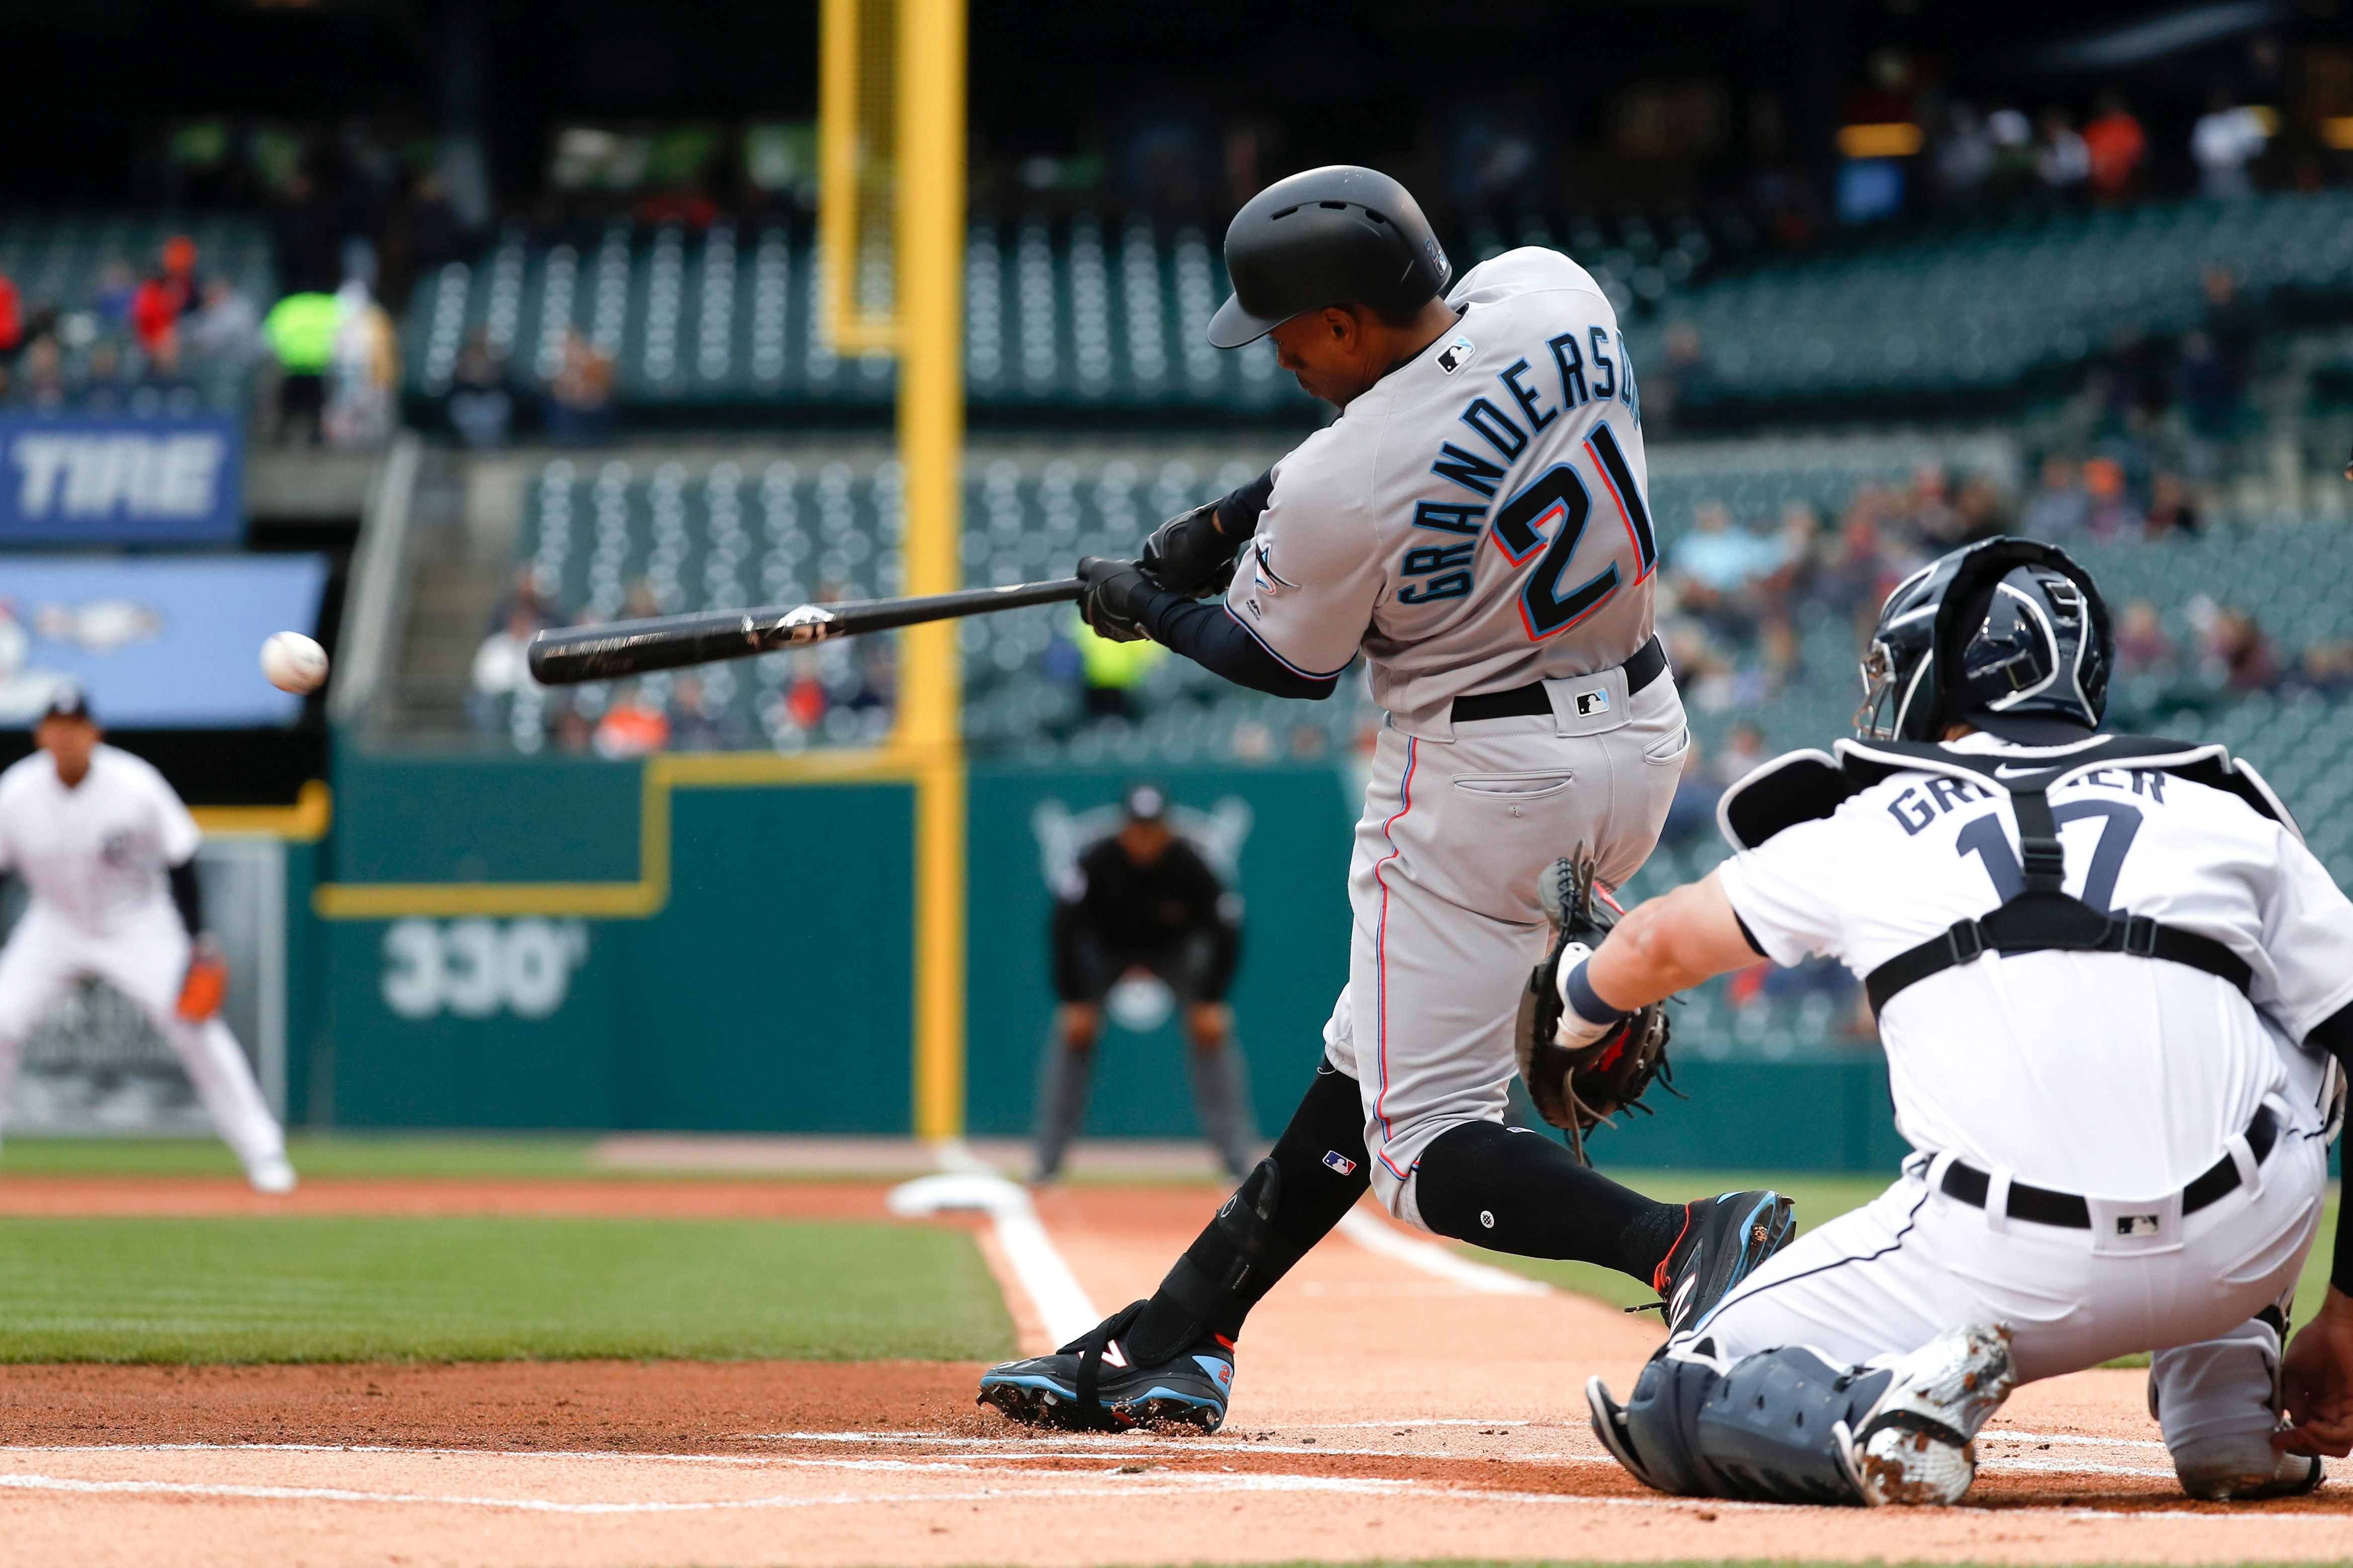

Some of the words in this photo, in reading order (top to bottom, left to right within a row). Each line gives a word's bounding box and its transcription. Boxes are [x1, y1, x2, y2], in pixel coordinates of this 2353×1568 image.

[11, 431, 223, 520] TIRE
[1492, 420, 1659, 641] 21
[1956, 799, 2144, 959] 17
